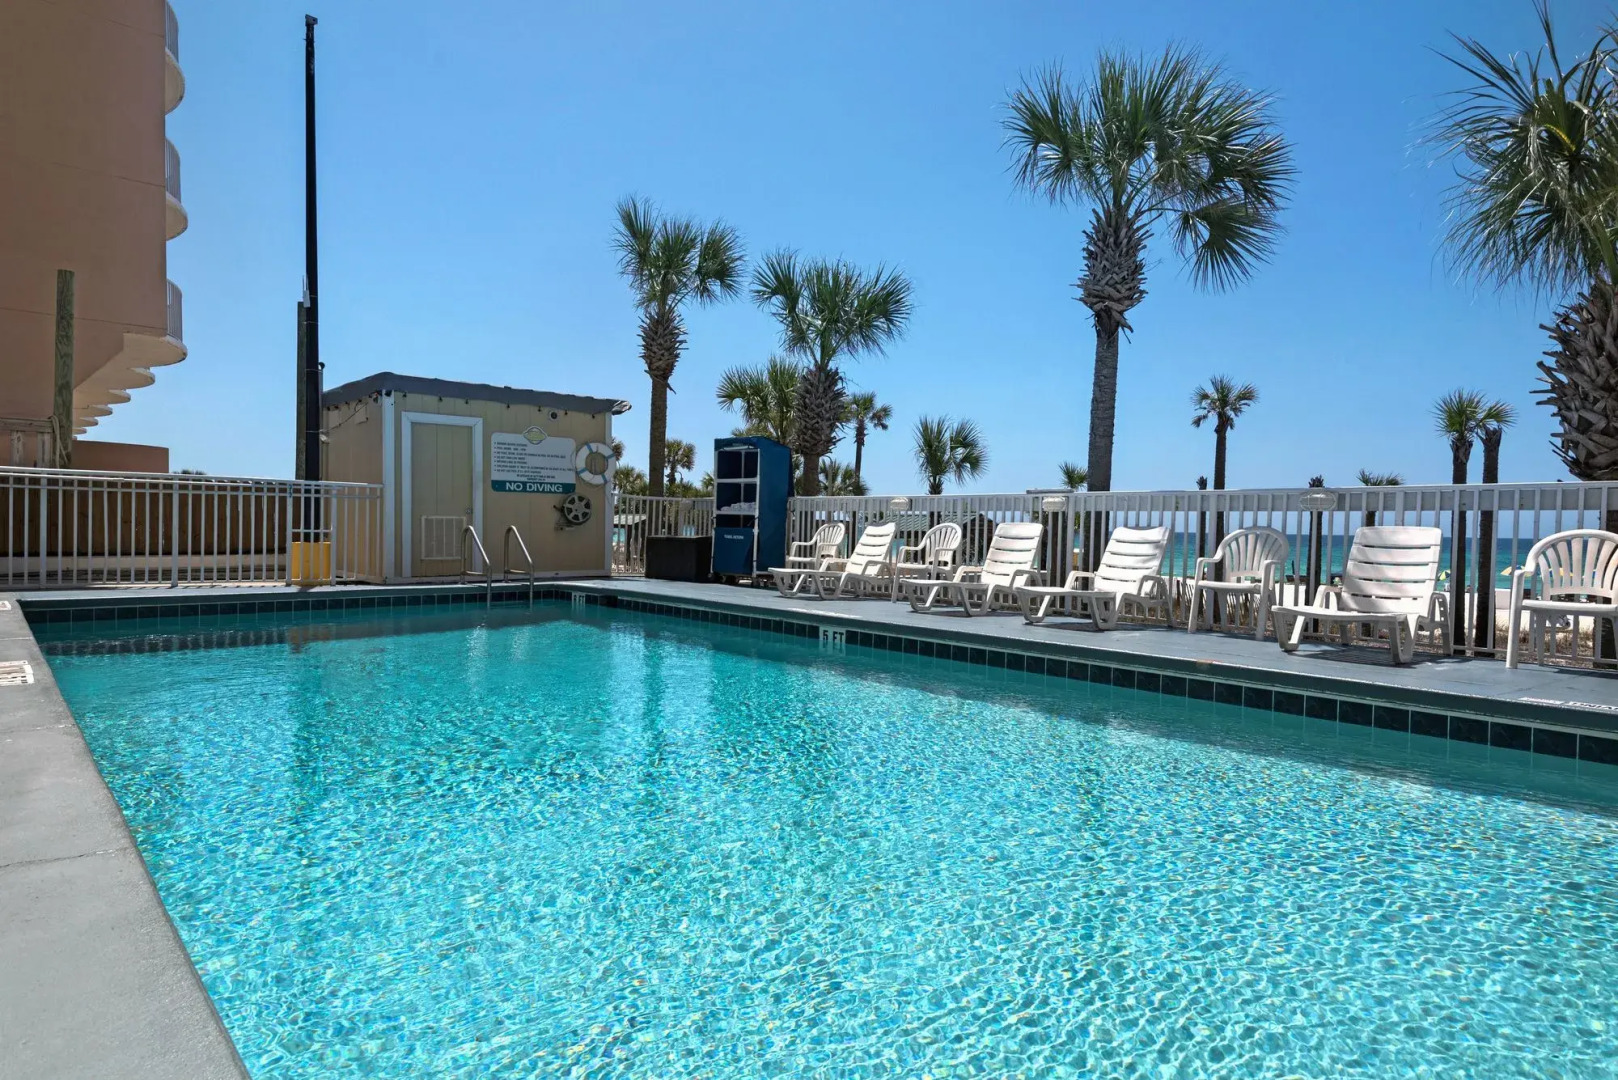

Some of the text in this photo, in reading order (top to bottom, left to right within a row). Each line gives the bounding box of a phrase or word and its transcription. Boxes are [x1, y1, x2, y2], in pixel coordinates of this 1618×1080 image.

[505, 482, 563, 492] NO DIVING
[823, 630, 845, 643] 5 FT
